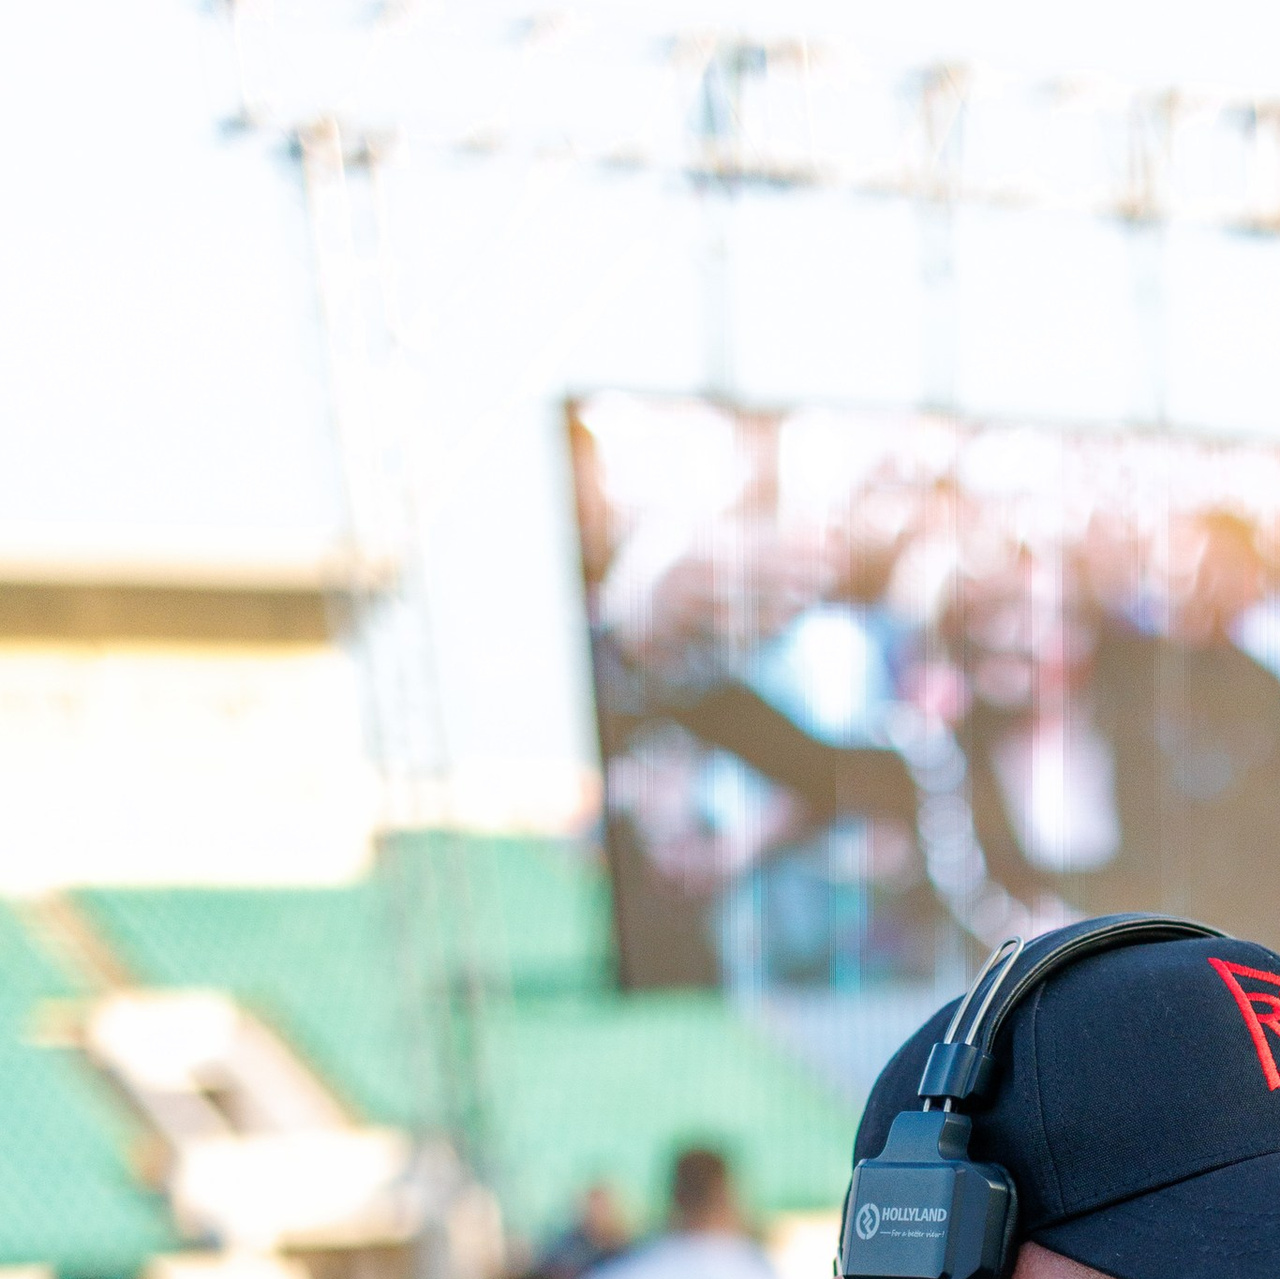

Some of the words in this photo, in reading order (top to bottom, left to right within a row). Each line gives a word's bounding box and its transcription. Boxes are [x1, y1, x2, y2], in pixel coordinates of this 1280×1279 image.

[881, 1207, 948, 1222] HOLLYLAND
[891, 1229, 901, 1237] For
[907, 1230, 924, 1238] better
